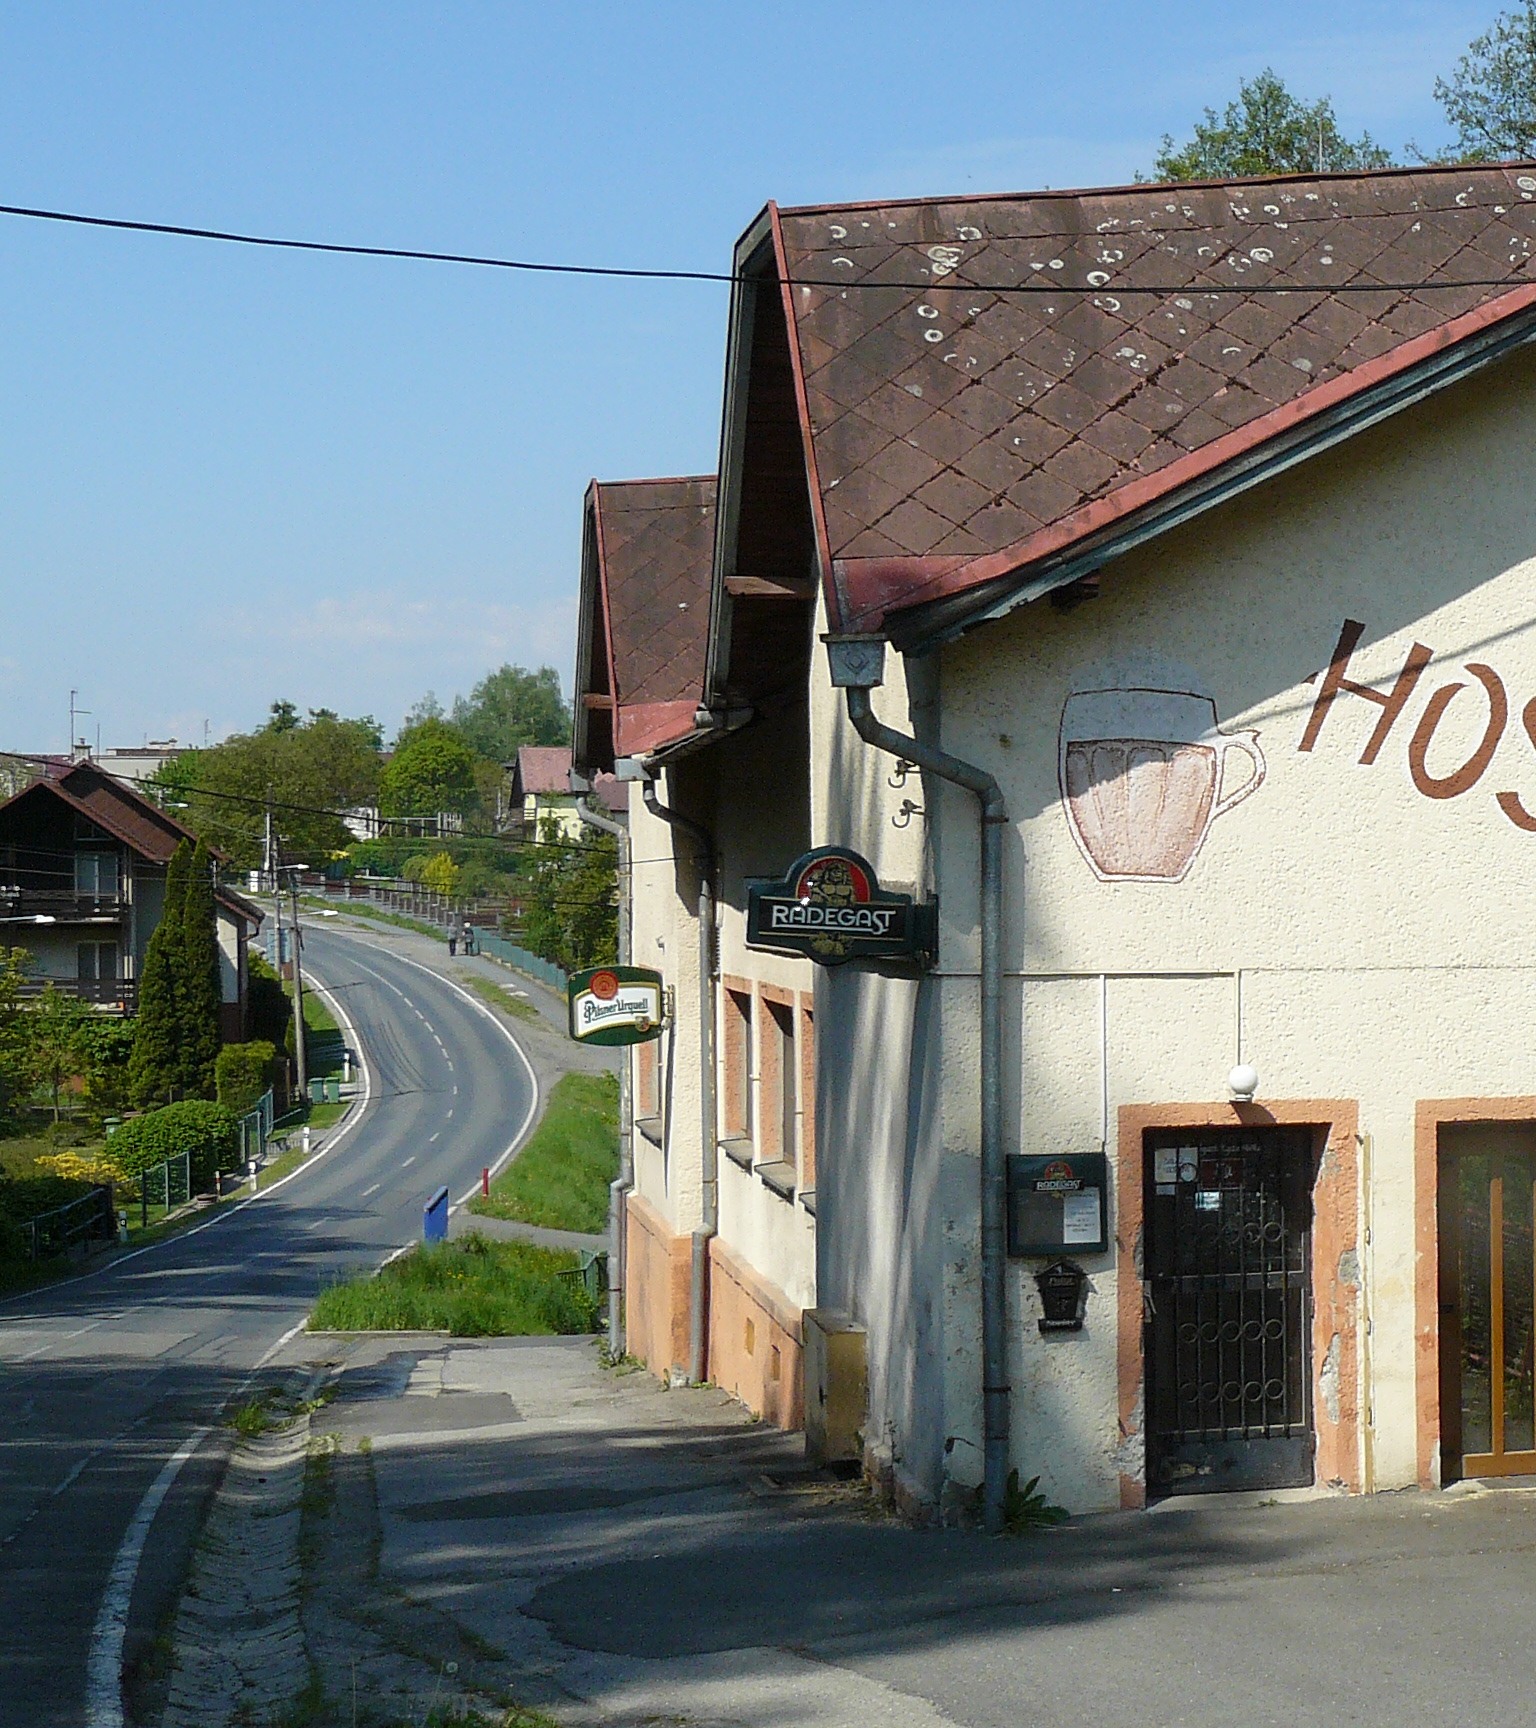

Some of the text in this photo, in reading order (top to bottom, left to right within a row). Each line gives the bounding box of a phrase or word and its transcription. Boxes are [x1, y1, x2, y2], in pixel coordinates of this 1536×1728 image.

[771, 904, 897, 935] RADEGAST
[583, 997, 649, 1024] Pilsner Urquell
